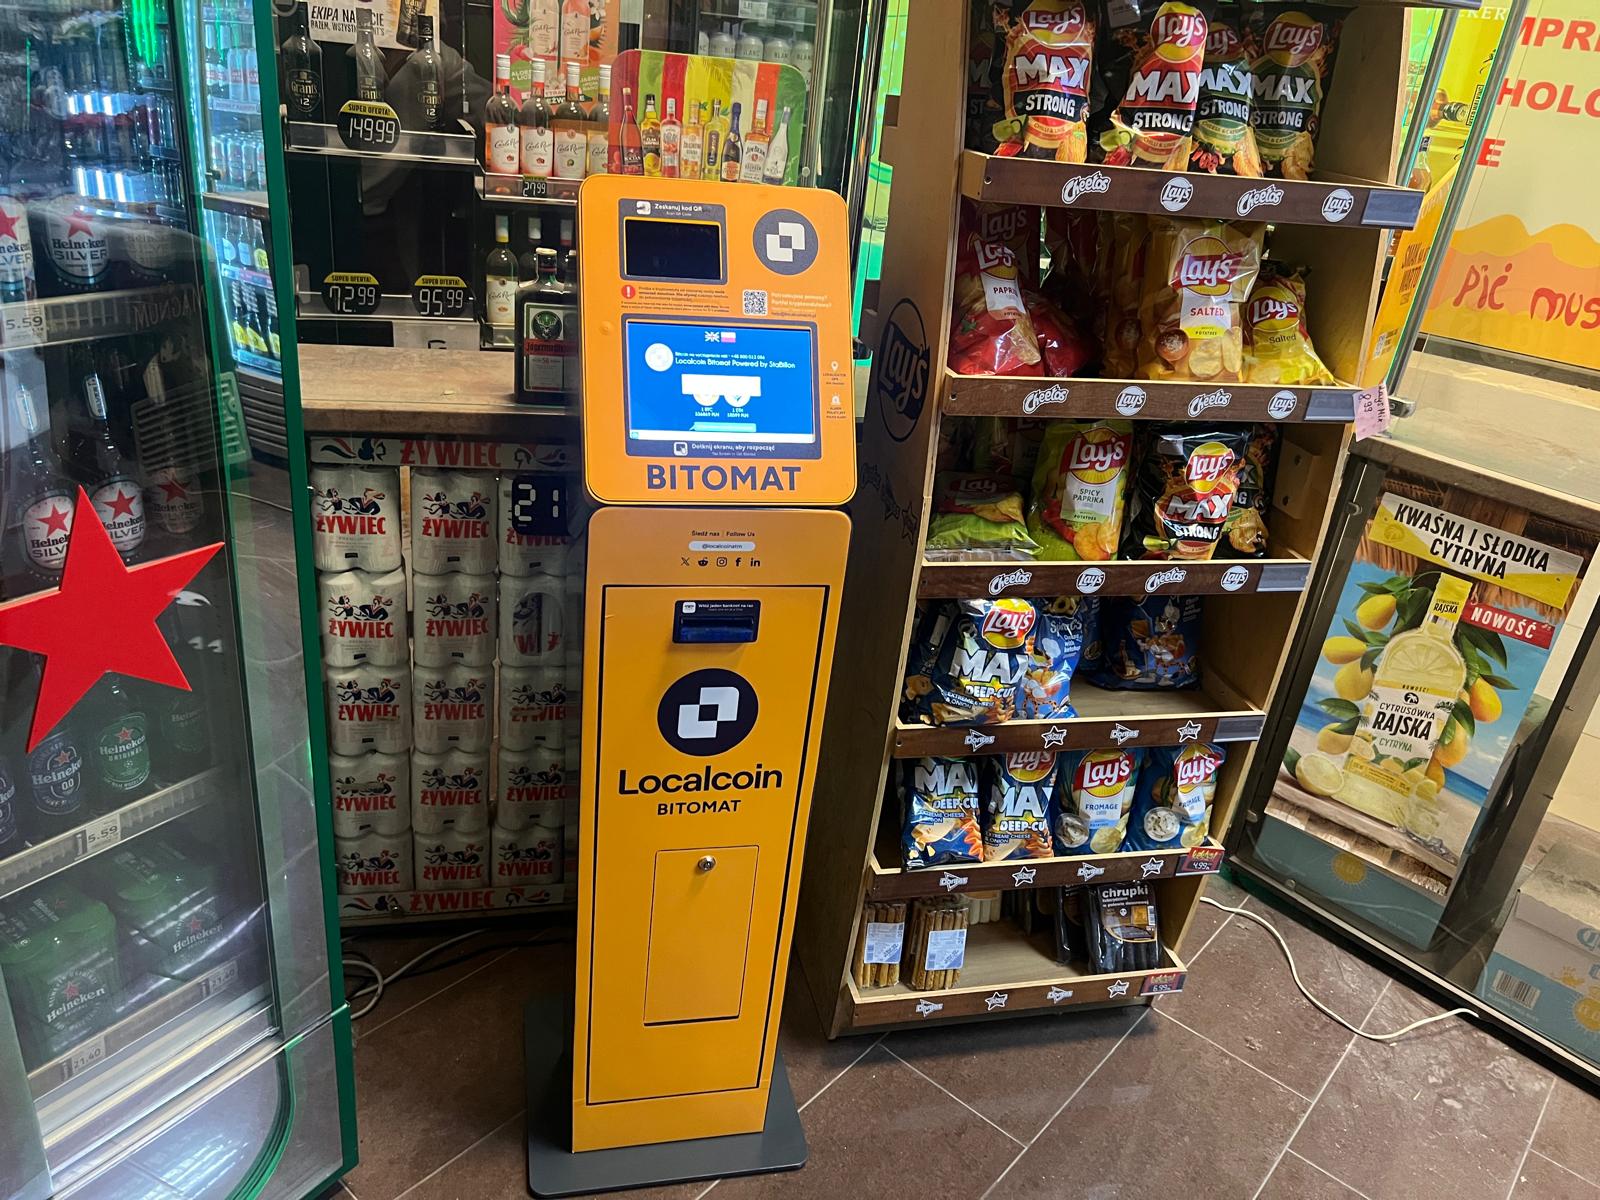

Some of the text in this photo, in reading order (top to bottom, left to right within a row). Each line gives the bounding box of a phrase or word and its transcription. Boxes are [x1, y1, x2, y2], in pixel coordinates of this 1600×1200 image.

[311, 5, 339, 21] EKIPA
[1029, 6, 1082, 33] Lay's
[1157, 15, 1205, 47] Lay's
[1268, 22, 1322, 53] Lay's
[1014, 54, 1090, 89] MAX
[1126, 71, 1201, 104] MAX
[1200, 67, 1254, 98] MAX
[1252, 74, 1315, 104] MAX
[300, 97, 311, 107] 12
[348, 103, 364, 112] SUPER
[1025, 94, 1076, 117] STRONG
[1200, 99, 1250, 120] STRONG
[1132, 112, 1193, 133] STRONG
[1252, 110, 1304, 128] STRONG
[349, 117, 396, 144] 149.99
[1062, 171, 1111, 204] Cheetos
[1236, 184, 1285, 217] Cheetos
[655, 203, 681, 212] Zeskanuj
[52, 238, 105, 250] Heineken
[53, 250, 107, 261] SILVER
[331, 274, 350, 282] SUPER
[1179, 252, 1233, 287] Lay's
[421, 277, 439, 285] SUPER
[1453, 263, 1513, 310] Pić
[329, 286, 376, 313] 72.99
[419, 289, 463, 315] 95.99
[1190, 306, 1225, 317] SALTED
[1253, 299, 1298, 324] Lay's
[6, 316, 43, 331] 5.59
[1269, 333, 1296, 344] Salted
[675, 357, 706, 365] Localcoin
[732, 360, 759, 368] Powered
[1022, 384, 1070, 415] Cheetos
[1188, 388, 1232, 417] Cheetos
[400, 440, 502, 467] ŻYWIEC
[692, 443, 713, 451] Dotknij
[1069, 437, 1125, 471] Lay's
[647, 465, 802, 491] BITOMAT
[1188, 454, 1233, 482] Lay's
[1072, 495, 1105, 504] PAPRIKA
[1080, 487, 1101, 497] SPICY
[1165, 494, 1233, 521] MAX
[316, 514, 387, 536] ŻYWIEC
[422, 517, 489, 539] ŻYWIEC
[1174, 523, 1219, 540] STRONG
[31, 533, 71, 550] Heinek
[1393, 503, 1550, 572] KWAŚNA I SŁODKA
[32, 547, 67, 560] SILV
[1429, 538, 1507, 580] CYTRYNA
[989, 568, 1032, 595] Cheetos
[1145, 567, 1187, 593] Cheetos
[1433, 602, 1458, 614] RAJSKA
[328, 617, 394, 639] ŻYWIEC
[425, 617, 488, 638] ŻYWIEC
[983, 609, 1033, 637] Lay's
[1470, 607, 1537, 640] NOWOŚĆ
[965, 685, 1016, 699] DEEP-CUT
[338, 703, 400, 722] ŻYWIEC
[424, 701, 485, 721] ŻYWIEC
[1379, 702, 1436, 721] CYTRUSÓWKA
[1371, 711, 1433, 741] RAJSKA
[1378, 737, 1413, 753] CYTRYNA
[618, 763, 783, 795] Localcoin
[1082, 755, 1130, 788] Lay's
[1177, 754, 1216, 785] Lay's
[335, 794, 397, 812] ŻYWIEC
[420, 789, 482, 806] ŻYWIEC
[657, 799, 742, 816] BITOMAT
[1085, 803, 1119, 811] FROMAGE
[87, 825, 118, 843] 5.59
[423, 864, 484, 881] ŻYWIEC
[410, 890, 496, 913] ŻYWIEC
[1102, 885, 1149, 898] chrupki
[172, 924, 223, 954] Heineken
[46, 987, 106, 1023] Heineken
[73, 1048, 101, 1067] 21.40
